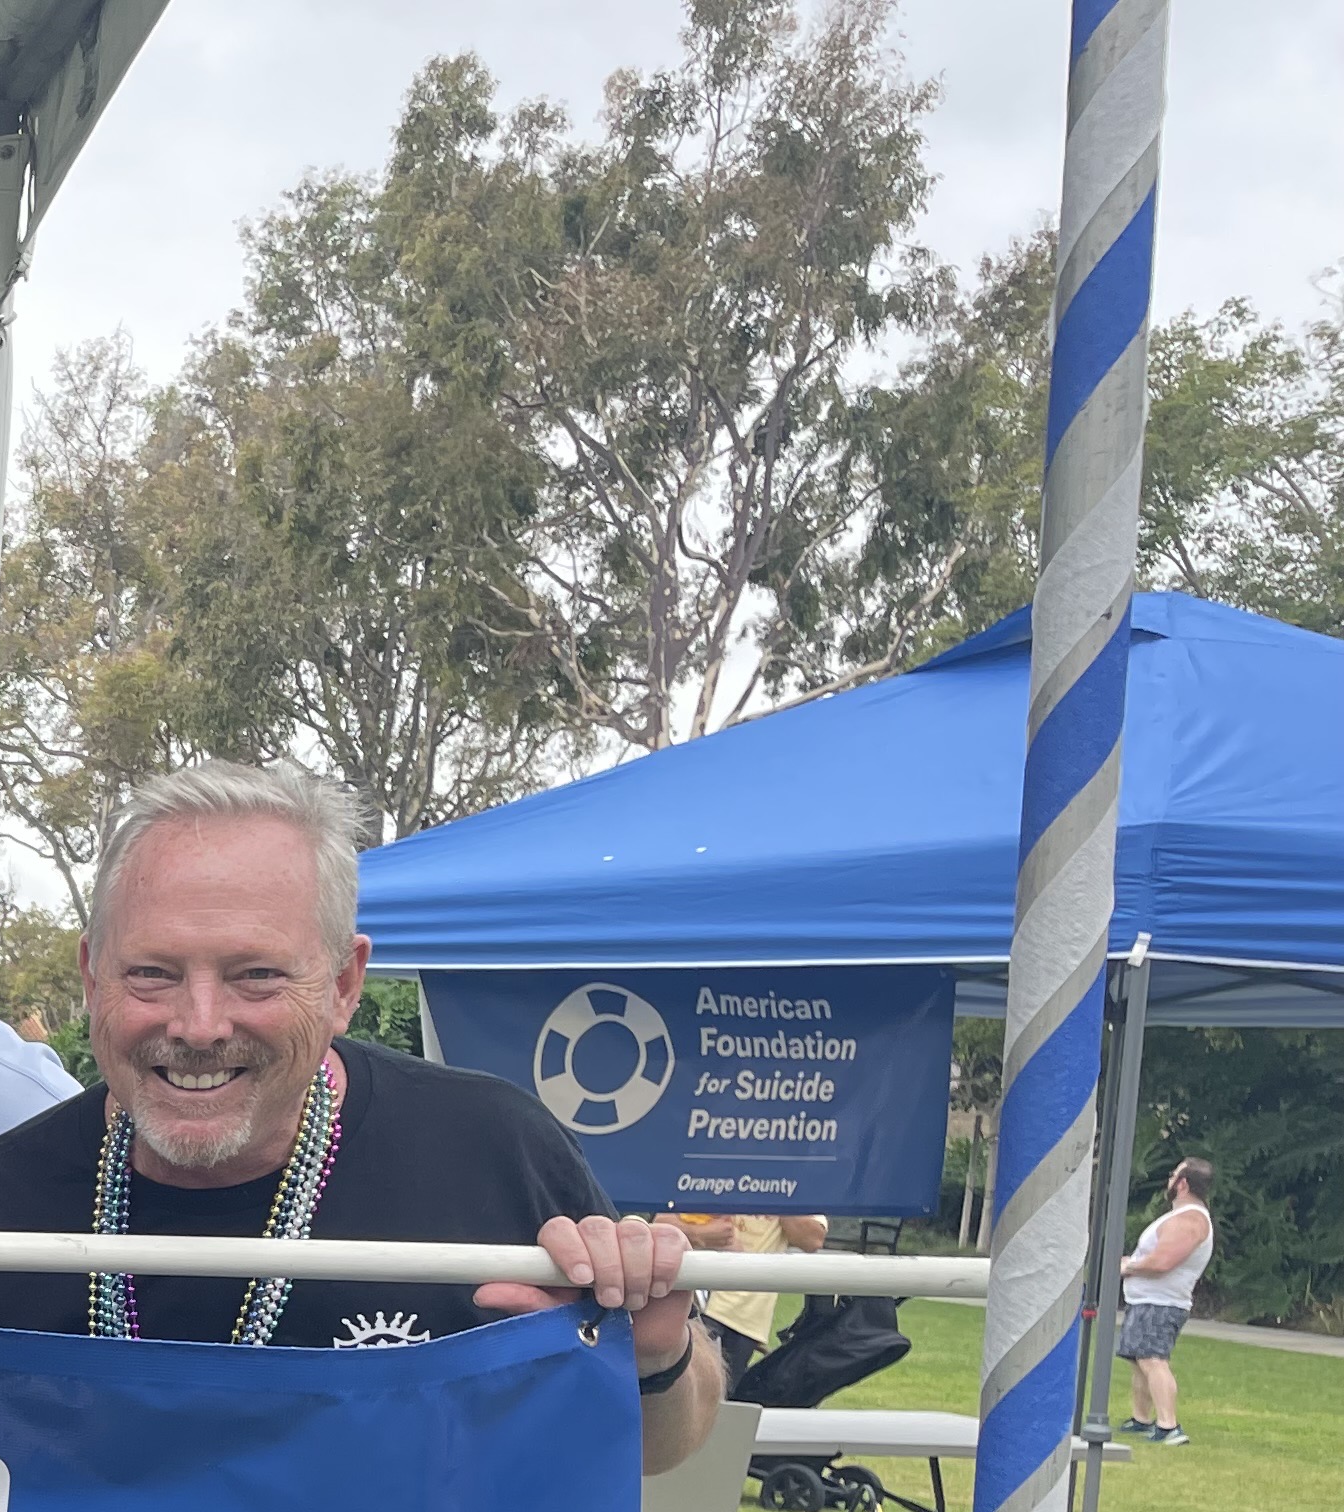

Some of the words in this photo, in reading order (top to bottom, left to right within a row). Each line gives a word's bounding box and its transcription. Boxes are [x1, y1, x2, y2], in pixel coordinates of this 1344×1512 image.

[696, 987, 831, 1019] American
[701, 1028, 856, 1060] Foundation
[695, 1072, 731, 1096] for
[735, 1070, 834, 1101] Suicide
[688, 1109, 837, 1141] Prevention
[678, 1174, 735, 1194] Orange
[738, 1175, 797, 1197] County
